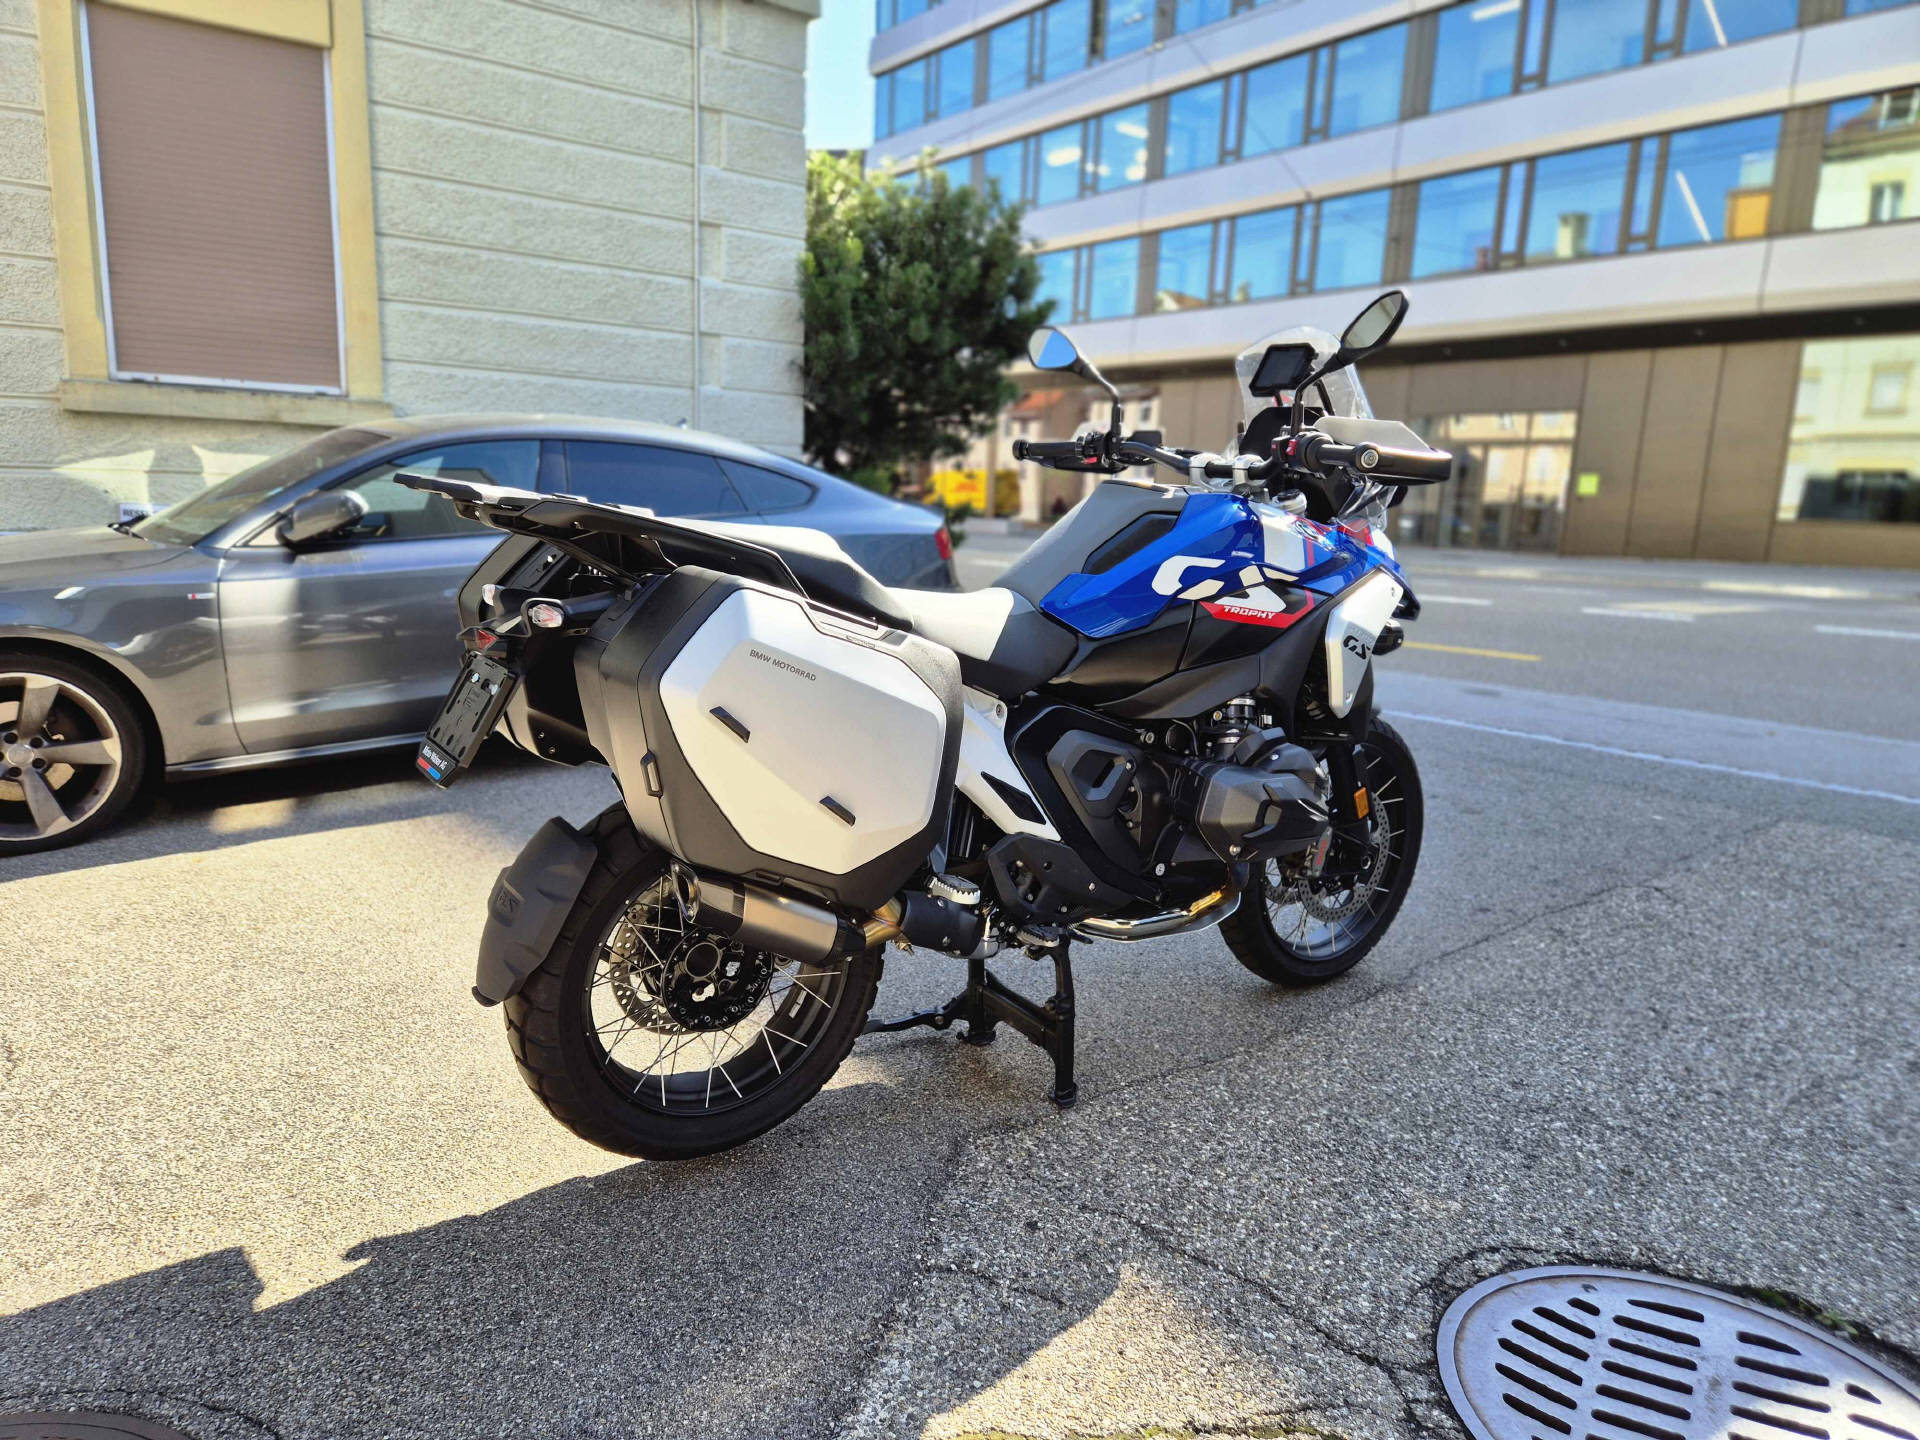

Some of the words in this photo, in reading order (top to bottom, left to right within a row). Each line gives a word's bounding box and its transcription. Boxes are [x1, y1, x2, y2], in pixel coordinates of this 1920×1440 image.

[1151, 555, 1300, 613] GS
[1223, 605, 1276, 620] TROPHY
[1343, 635, 1371, 660] GS
[750, 649, 772, 662] BMW
[772, 659, 817, 681] MOTORRAD
